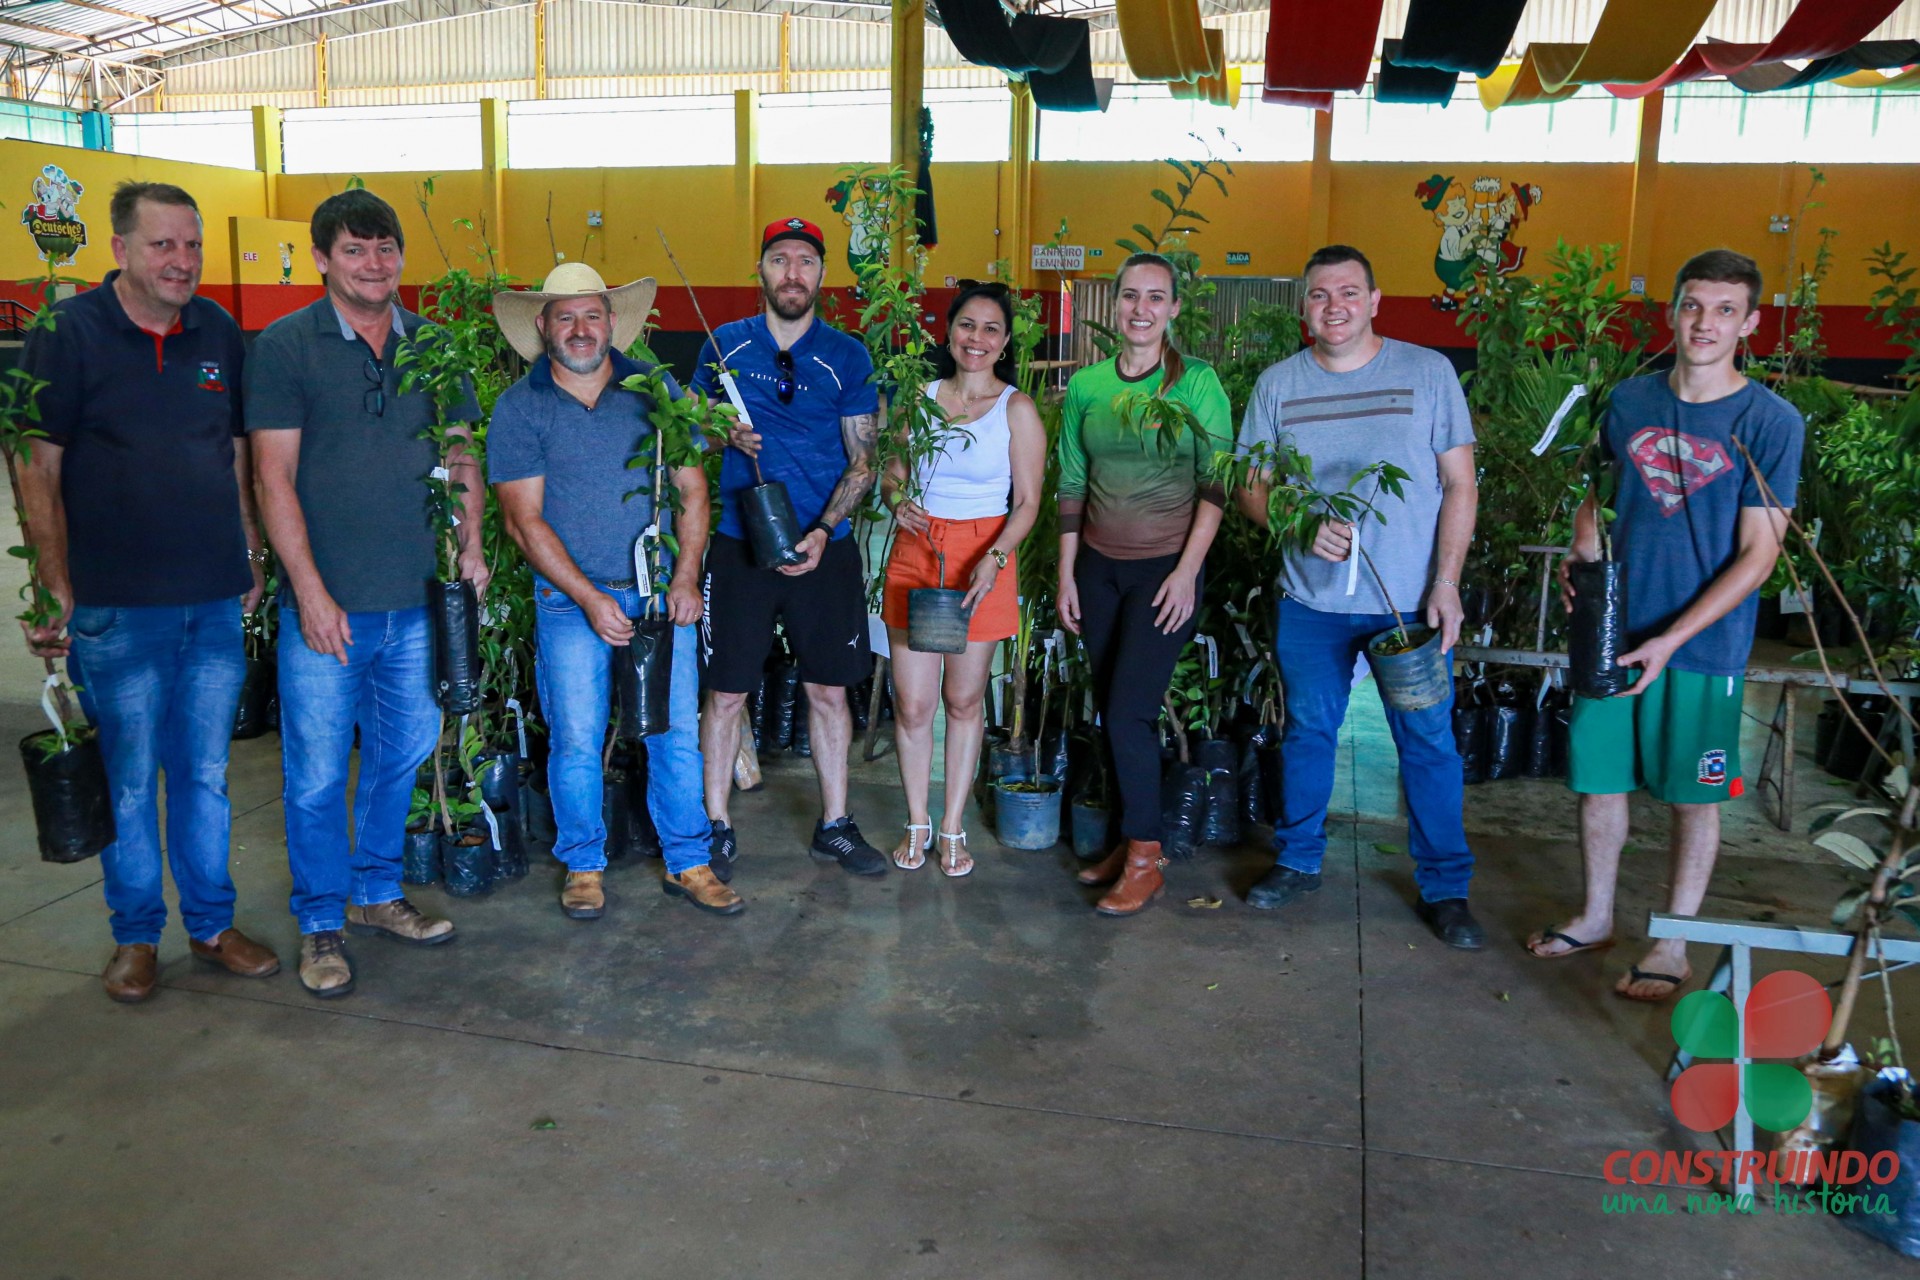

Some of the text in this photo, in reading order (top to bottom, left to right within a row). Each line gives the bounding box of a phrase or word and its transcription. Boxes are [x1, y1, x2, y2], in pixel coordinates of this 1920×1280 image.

[1034, 248, 1082, 257] BANHEIRO
[1227, 252, 1249, 260] SAÍDA
[1035, 259, 1079, 267] FEMININO
